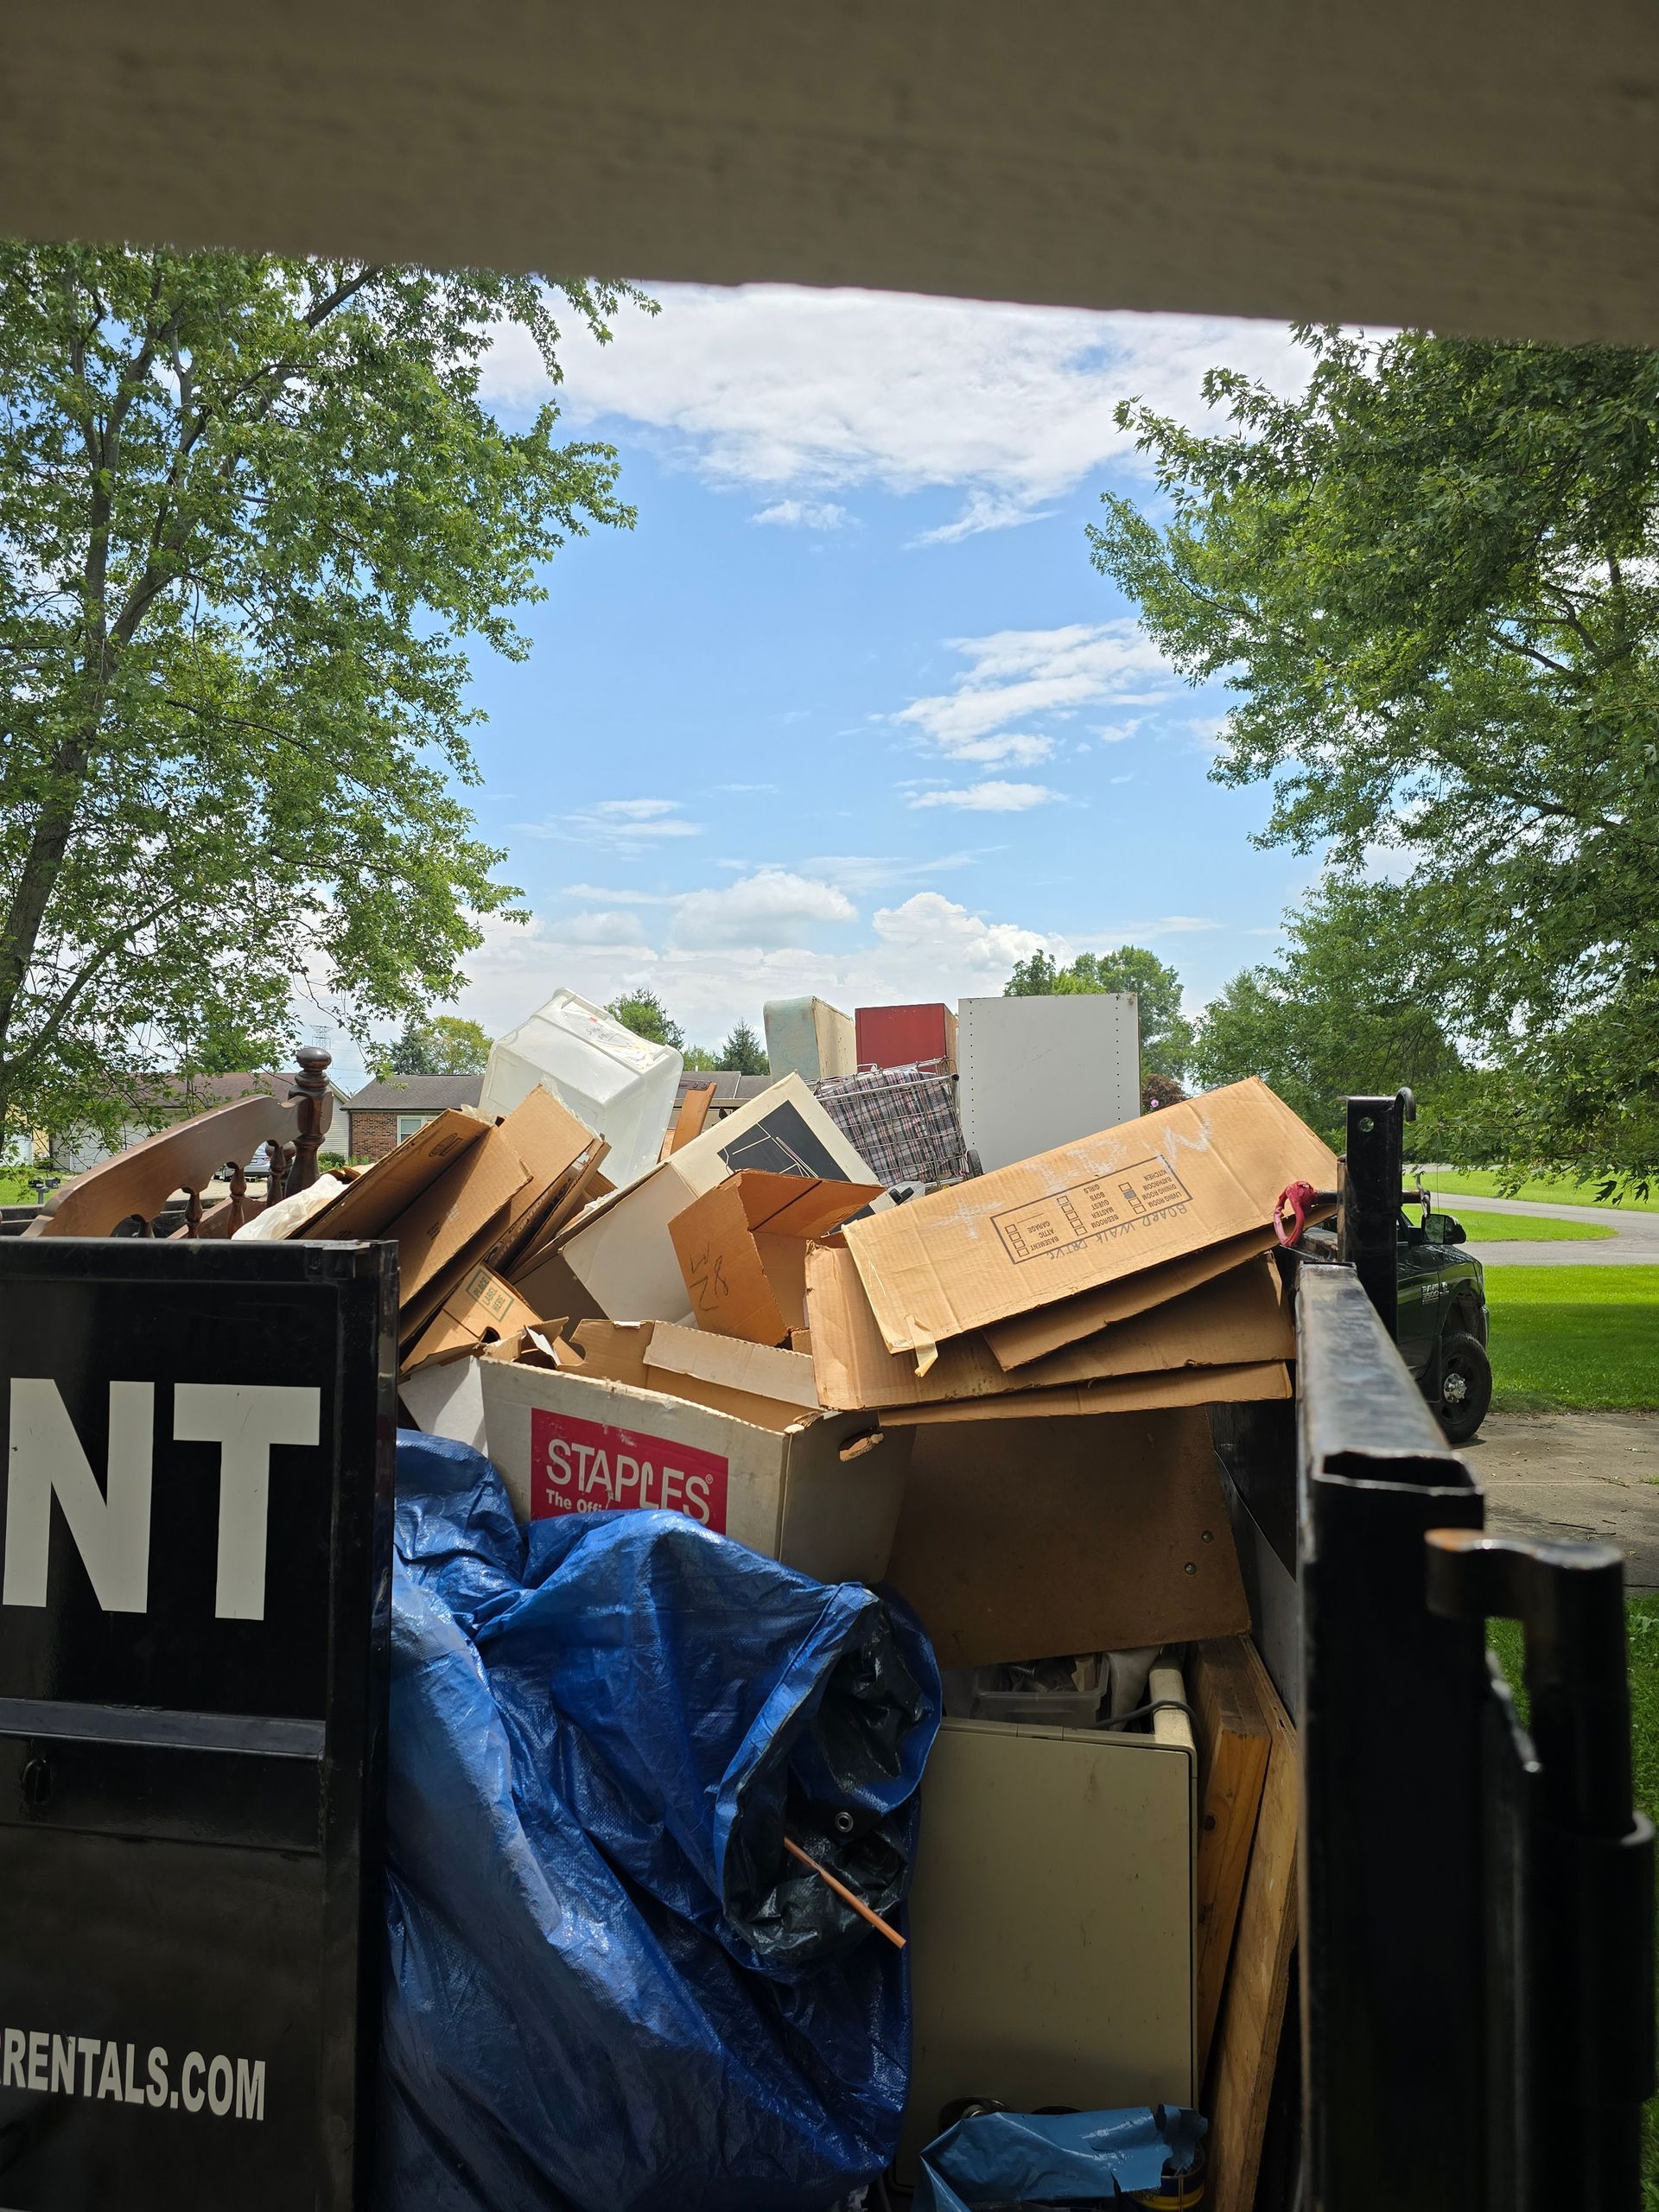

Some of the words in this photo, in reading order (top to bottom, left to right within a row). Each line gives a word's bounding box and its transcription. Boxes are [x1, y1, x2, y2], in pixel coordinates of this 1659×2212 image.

[1144, 1169, 1167, 1181] KITCHEN
[1083, 1184, 1100, 1194] GIRLS
[1142, 1177, 1172, 1192] BATHROOM
[1160, 1183, 1177, 1195] DINING
[1090, 1192, 1105, 1202] BOYS
[1141, 1190, 1159, 1201] ROOM
[1147, 1197, 1164, 1208] ROOM
[1164, 1191, 1182, 1202] LIVING
[1091, 1199, 1109, 1211] GUEST
[1091, 1206, 1114, 1218] MASTER
[1090, 1214, 1119, 1229] BEDROOM
[1142, 1203, 1187, 1227] BOARD
[1027, 1220, 1051, 1233] GARAGE
[1039, 1228, 1054, 1238] ATTIC
[1030, 1236, 1059, 1251] BASEMENT
[473, 1276, 490, 1298] PLACE
[482, 1287, 498, 1306] LABEL
[492, 1294, 506, 1313] HERE
[546, 1438, 710, 1525] STAPLES
[3, 1377, 321, 1621] NT
[546, 1488, 572, 1510] The
[0, 2027, 267, 2121] RENTALS.COM
